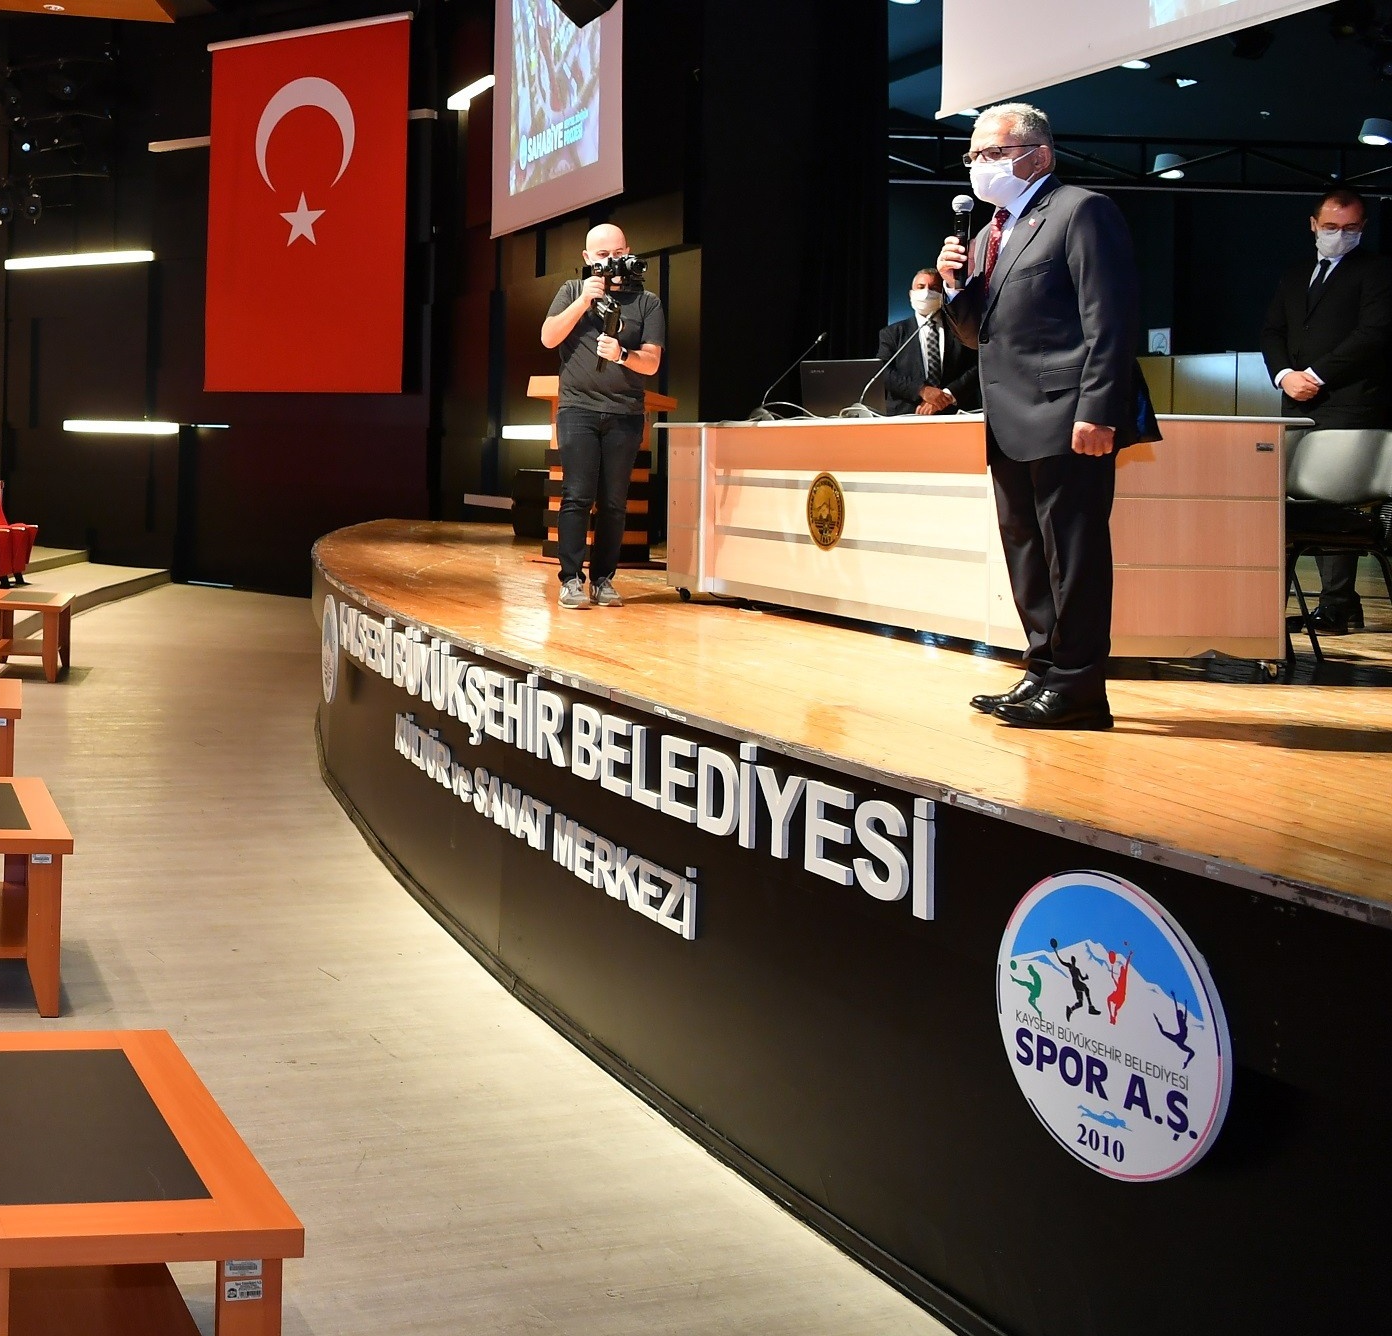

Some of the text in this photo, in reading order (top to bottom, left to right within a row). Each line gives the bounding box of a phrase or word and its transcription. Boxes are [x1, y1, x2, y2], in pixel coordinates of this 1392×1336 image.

[392, 626, 568, 768] BÜYÜKŞEHİR
[571, 703, 935, 921] BELEDİYESİ
[394, 712, 698, 941] KÜLTÜR ve SANAT MERKEZİ
[1015, 1008, 1190, 1091] KAYSERİ BÜYÜKŞEHİR BELEDİYESİ
[1015, 1027, 1198, 1142] SPOR A.Ş.
[1076, 1123, 1126, 1164] 2010
